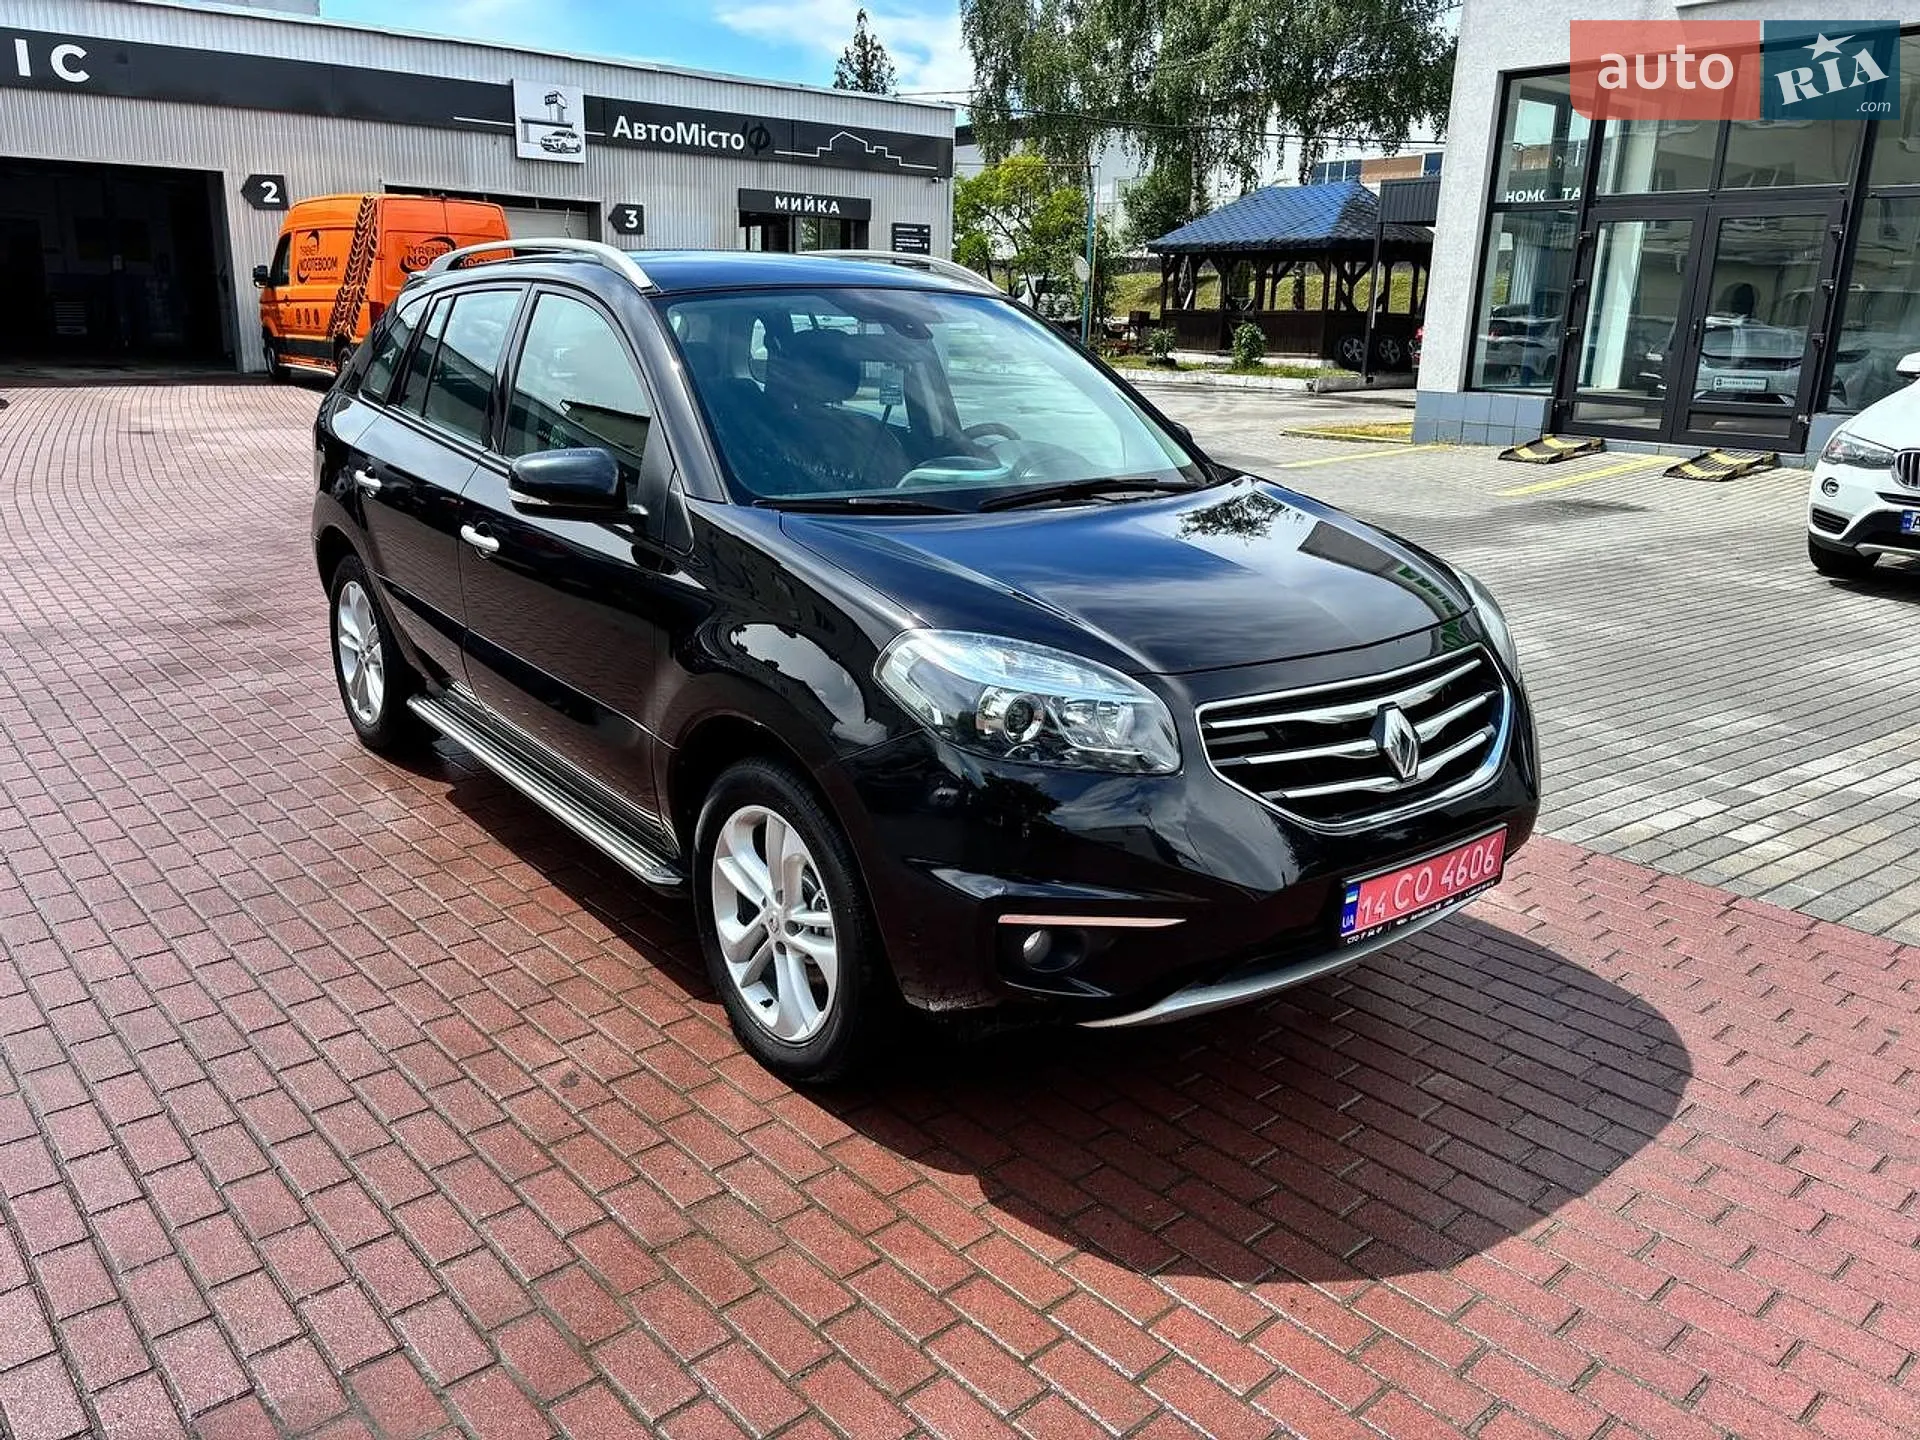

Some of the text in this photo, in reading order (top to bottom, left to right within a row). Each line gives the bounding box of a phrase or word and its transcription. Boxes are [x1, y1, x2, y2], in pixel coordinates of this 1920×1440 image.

[612, 115, 745, 150] АвтоМісто
[260, 181, 280, 203] 2
[775, 195, 840, 214] МИЙКА
[625, 209, 638, 228] 3
[1361, 890, 1386, 924] 14
[1394, 866, 1432, 910] CO
[1440, 838, 1497, 890] 4606
[1342, 915, 1354, 928] UA
